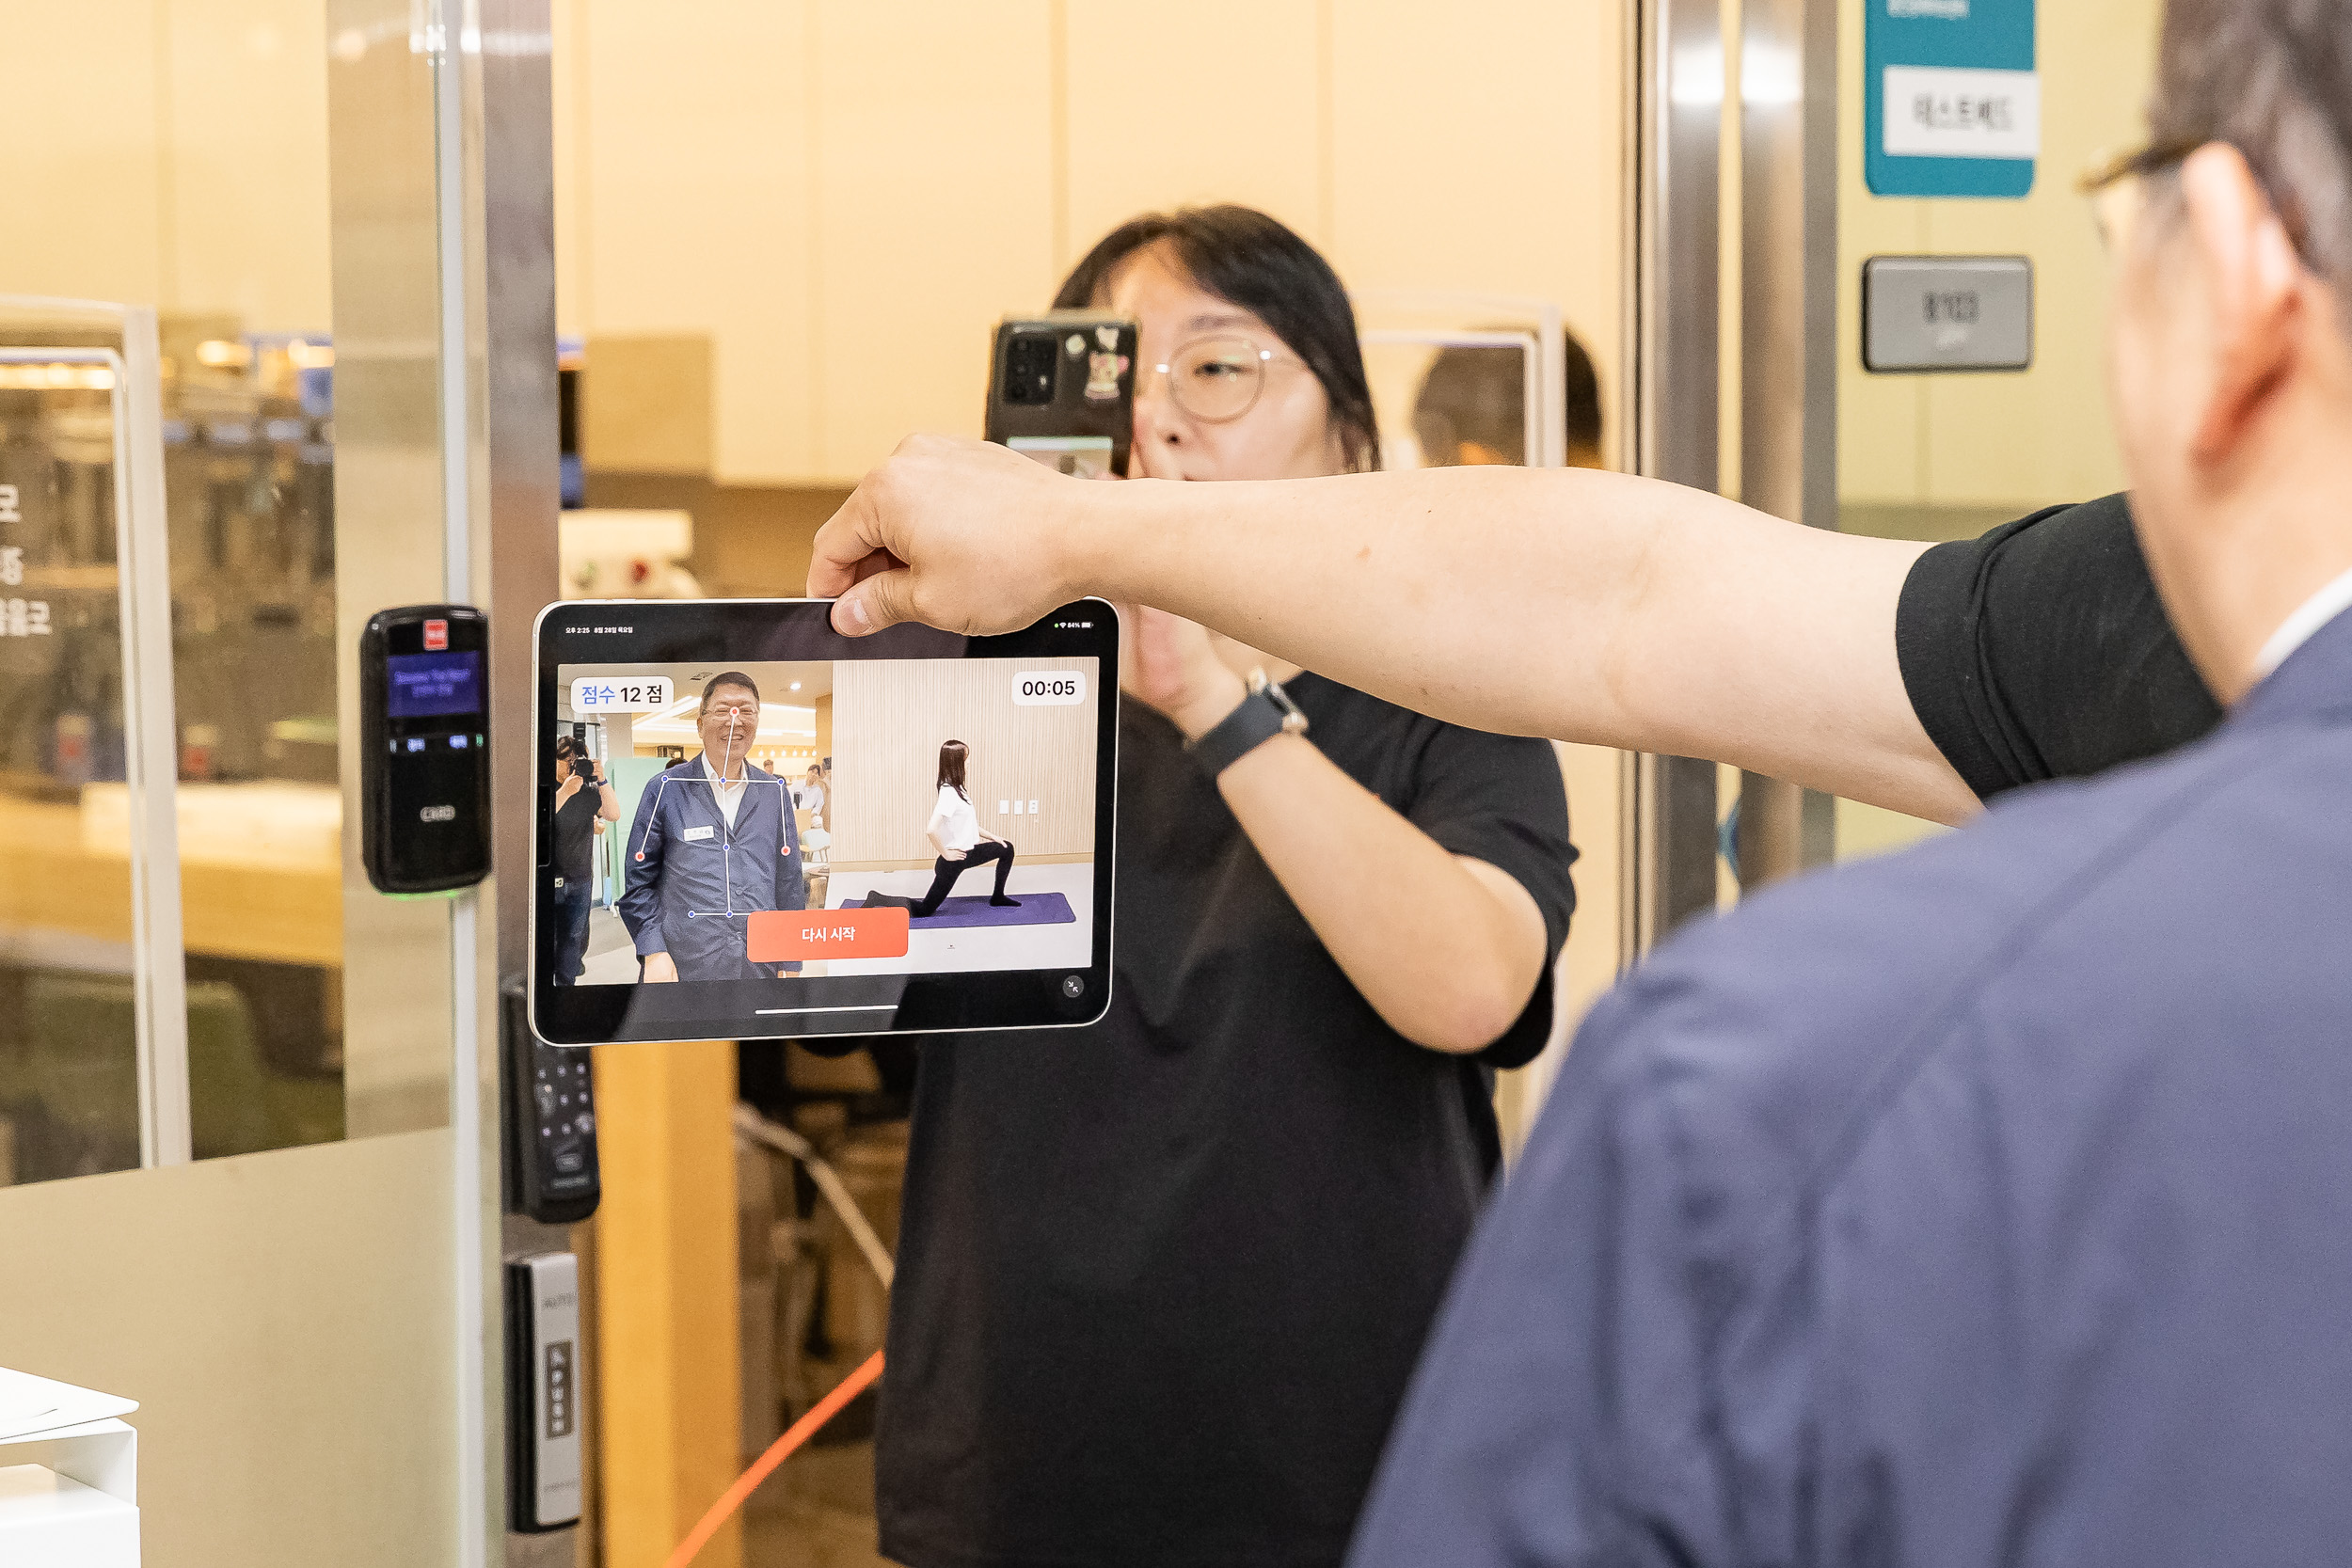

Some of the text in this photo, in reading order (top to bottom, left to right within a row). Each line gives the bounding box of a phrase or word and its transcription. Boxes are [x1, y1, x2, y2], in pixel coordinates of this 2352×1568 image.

[581, 684, 662, 705] 점수 12 점
[1022, 680, 1075, 696] 00:05
[802, 926, 856, 942] 다시 시작
